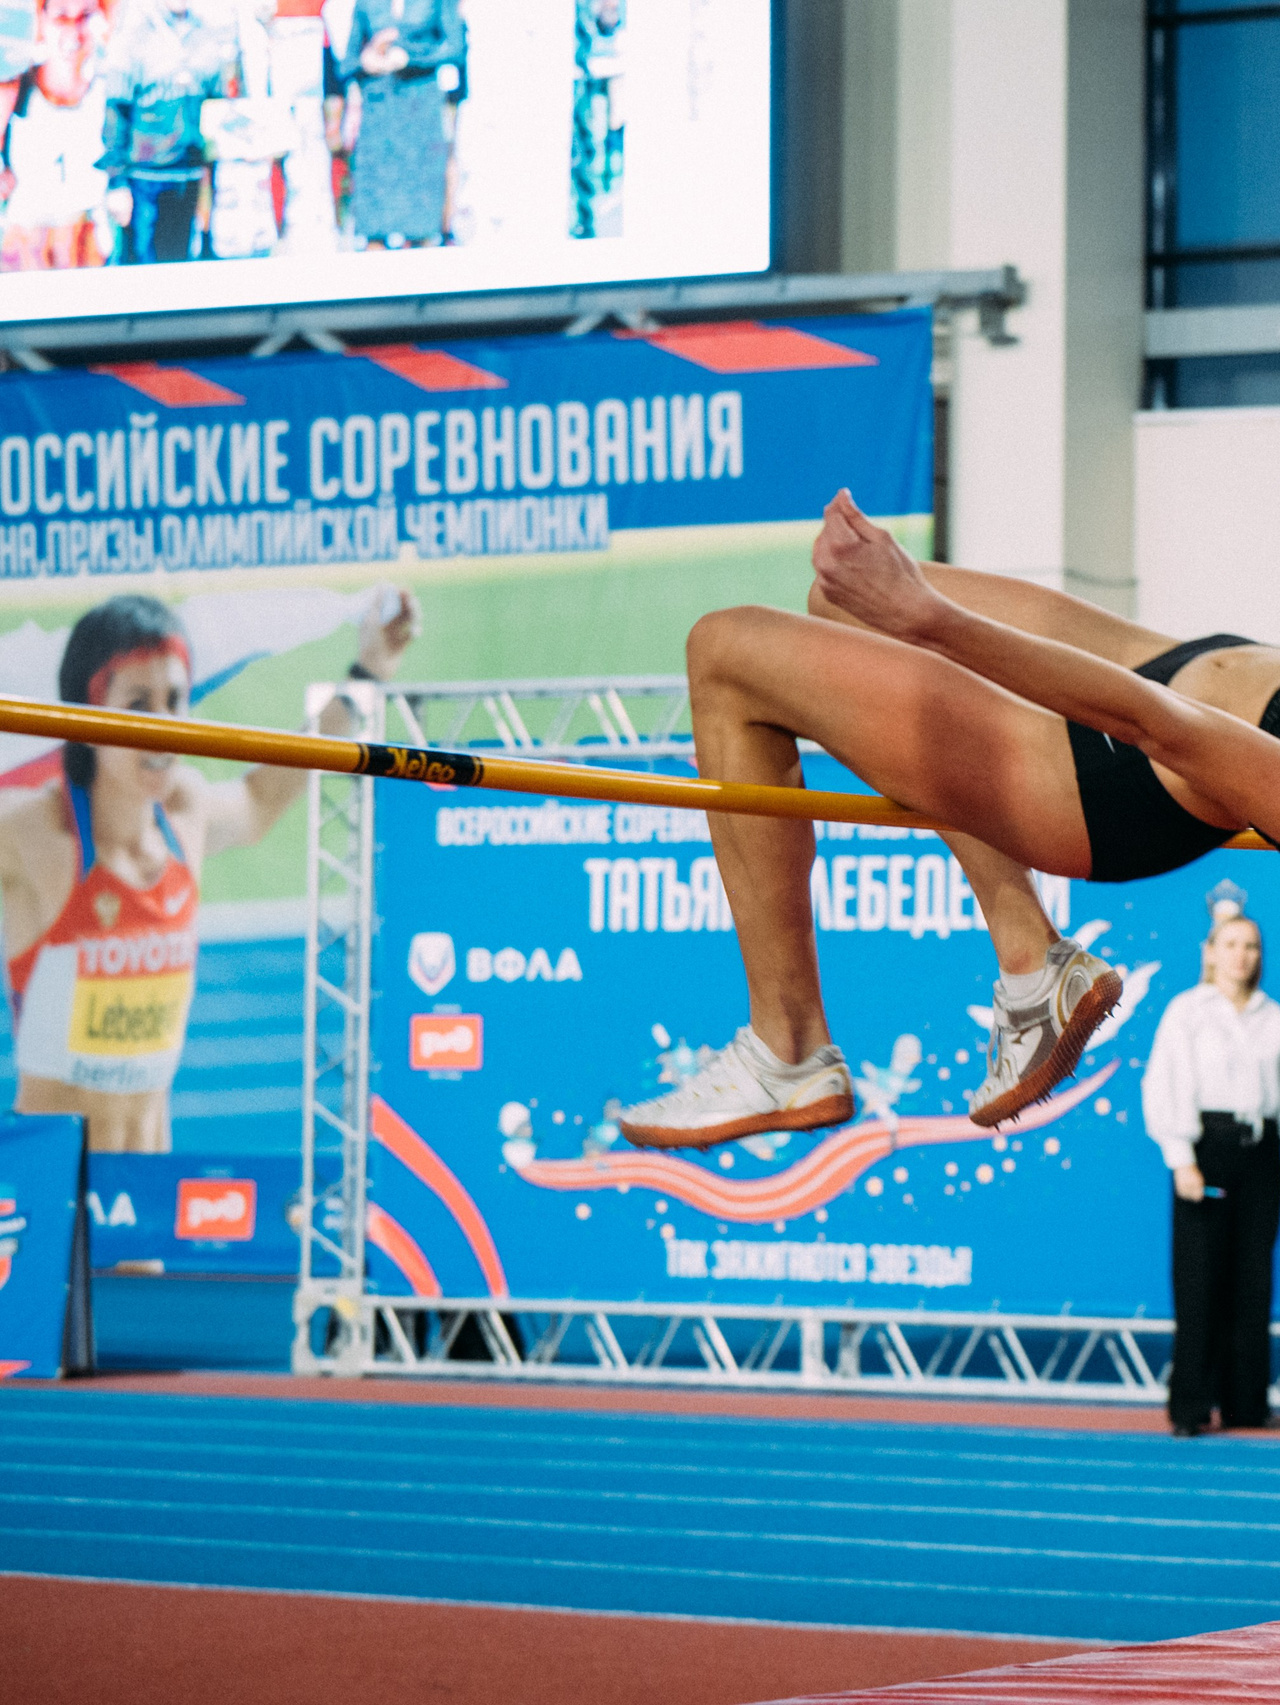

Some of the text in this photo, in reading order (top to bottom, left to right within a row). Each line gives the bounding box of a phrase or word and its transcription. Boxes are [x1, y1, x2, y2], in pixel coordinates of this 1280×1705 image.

[310, 391, 744, 500] СОРЕВНОВАНИЯ
[46, 516, 154, 571] ПРИЗЫ
[160, 492, 399, 568] ОЛИМПИЙСКОЙ
[404, 494, 608, 558] ЧЕМПИОНКИ
[384, 747, 457, 782] Nelco
[583, 856, 733, 933] ТАТЬЯ
[465, 947, 583, 982] ВФЛА
